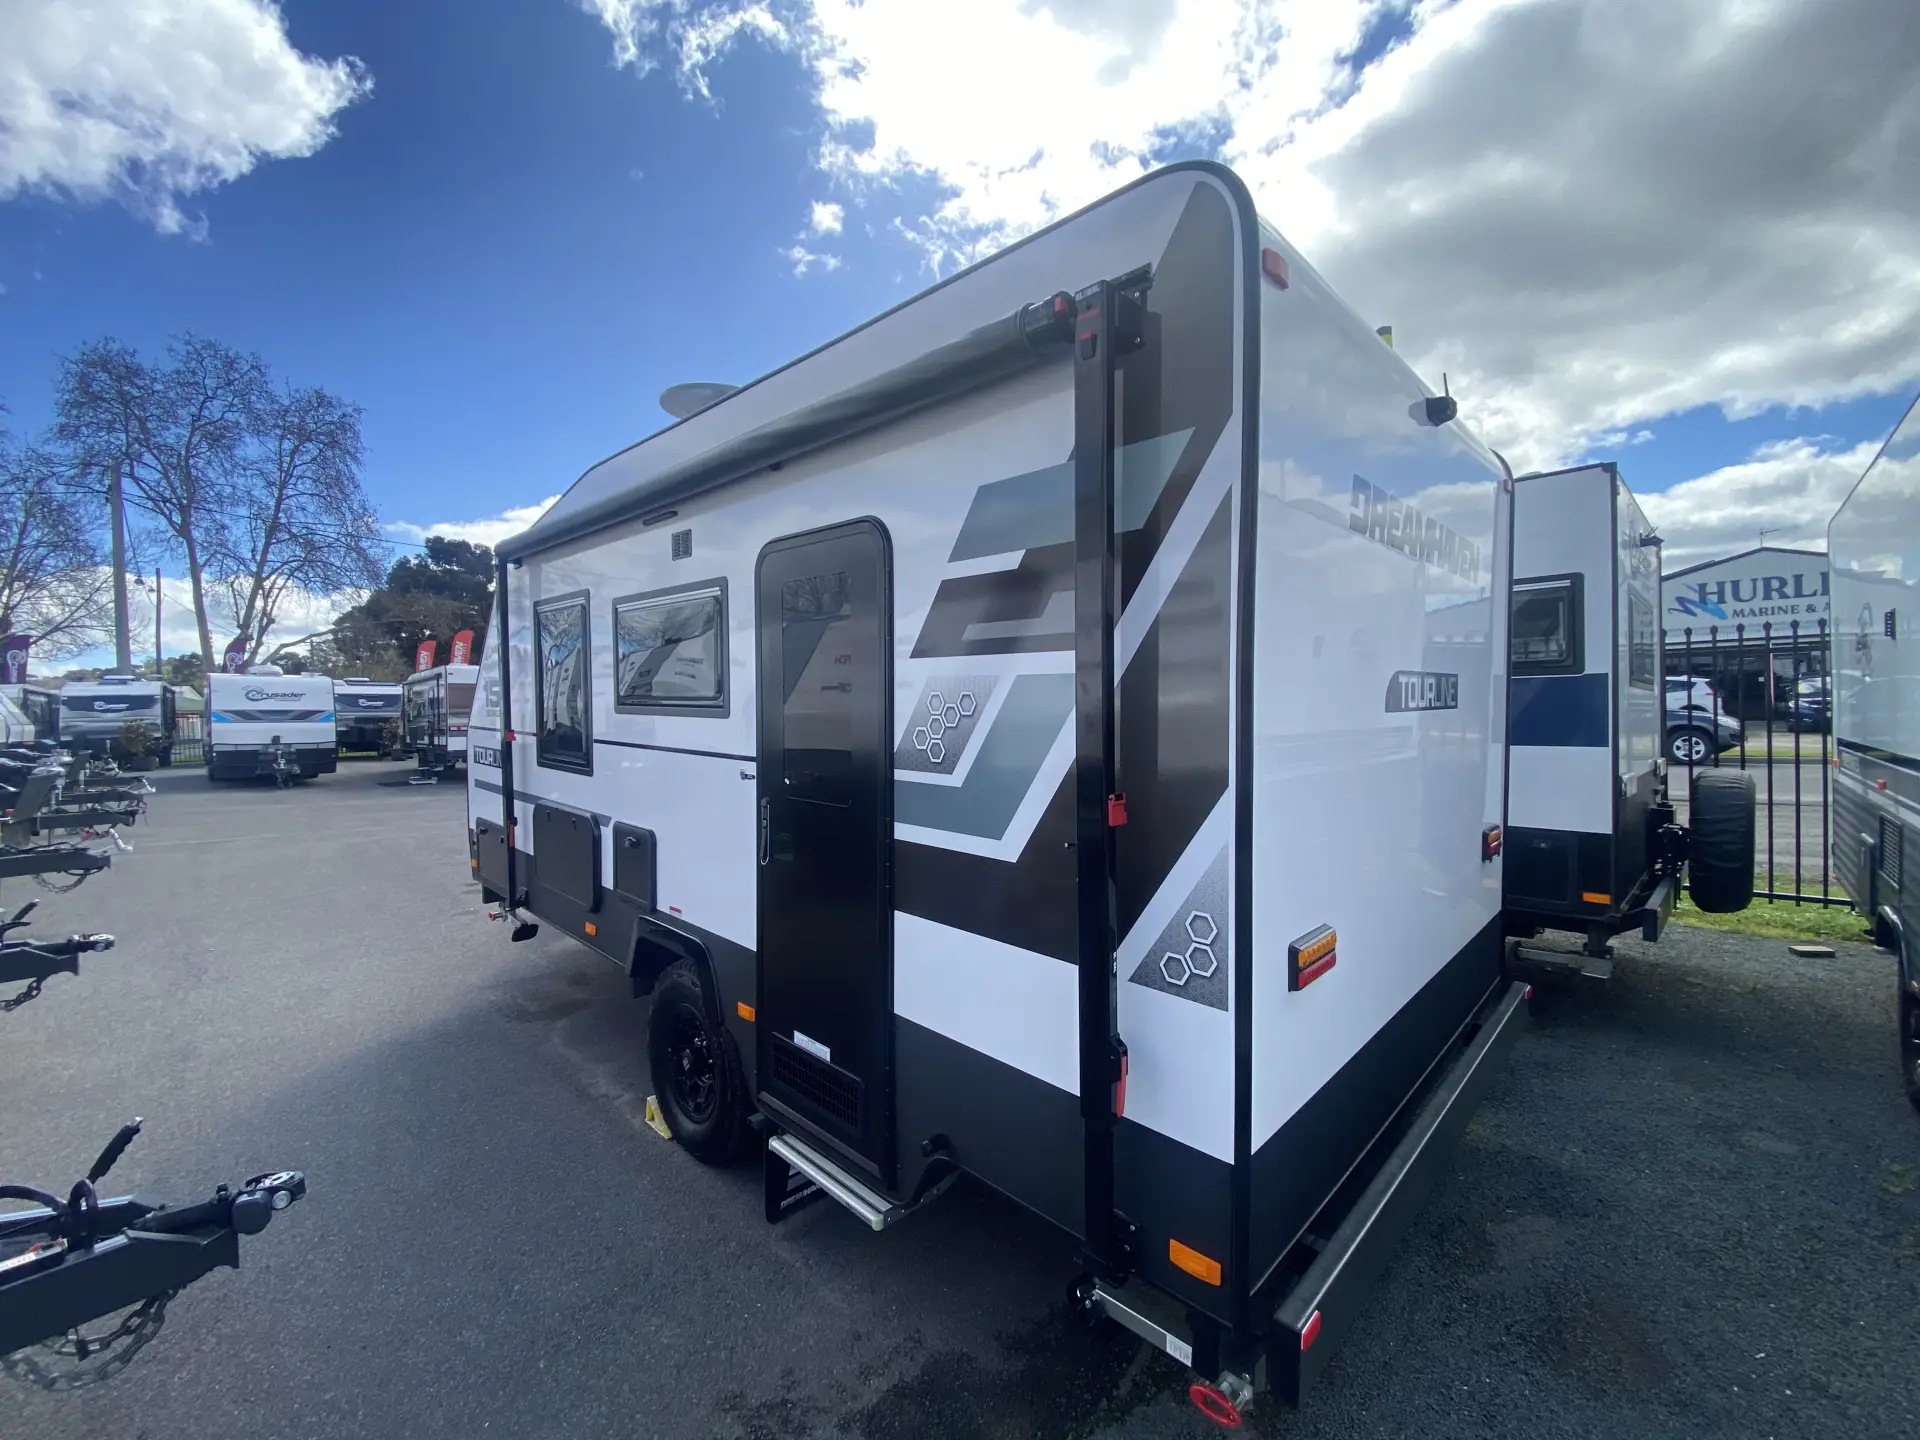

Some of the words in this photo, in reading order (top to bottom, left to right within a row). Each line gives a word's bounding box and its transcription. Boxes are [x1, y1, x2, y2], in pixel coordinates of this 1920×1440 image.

[1349, 472, 1480, 586] DREAMHAVEN
[1732, 603, 1800, 619] MARINE
[1804, 603, 1818, 613] &
[243, 688, 307, 701] Crusader
[1397, 674, 1457, 708] TOURLINE
